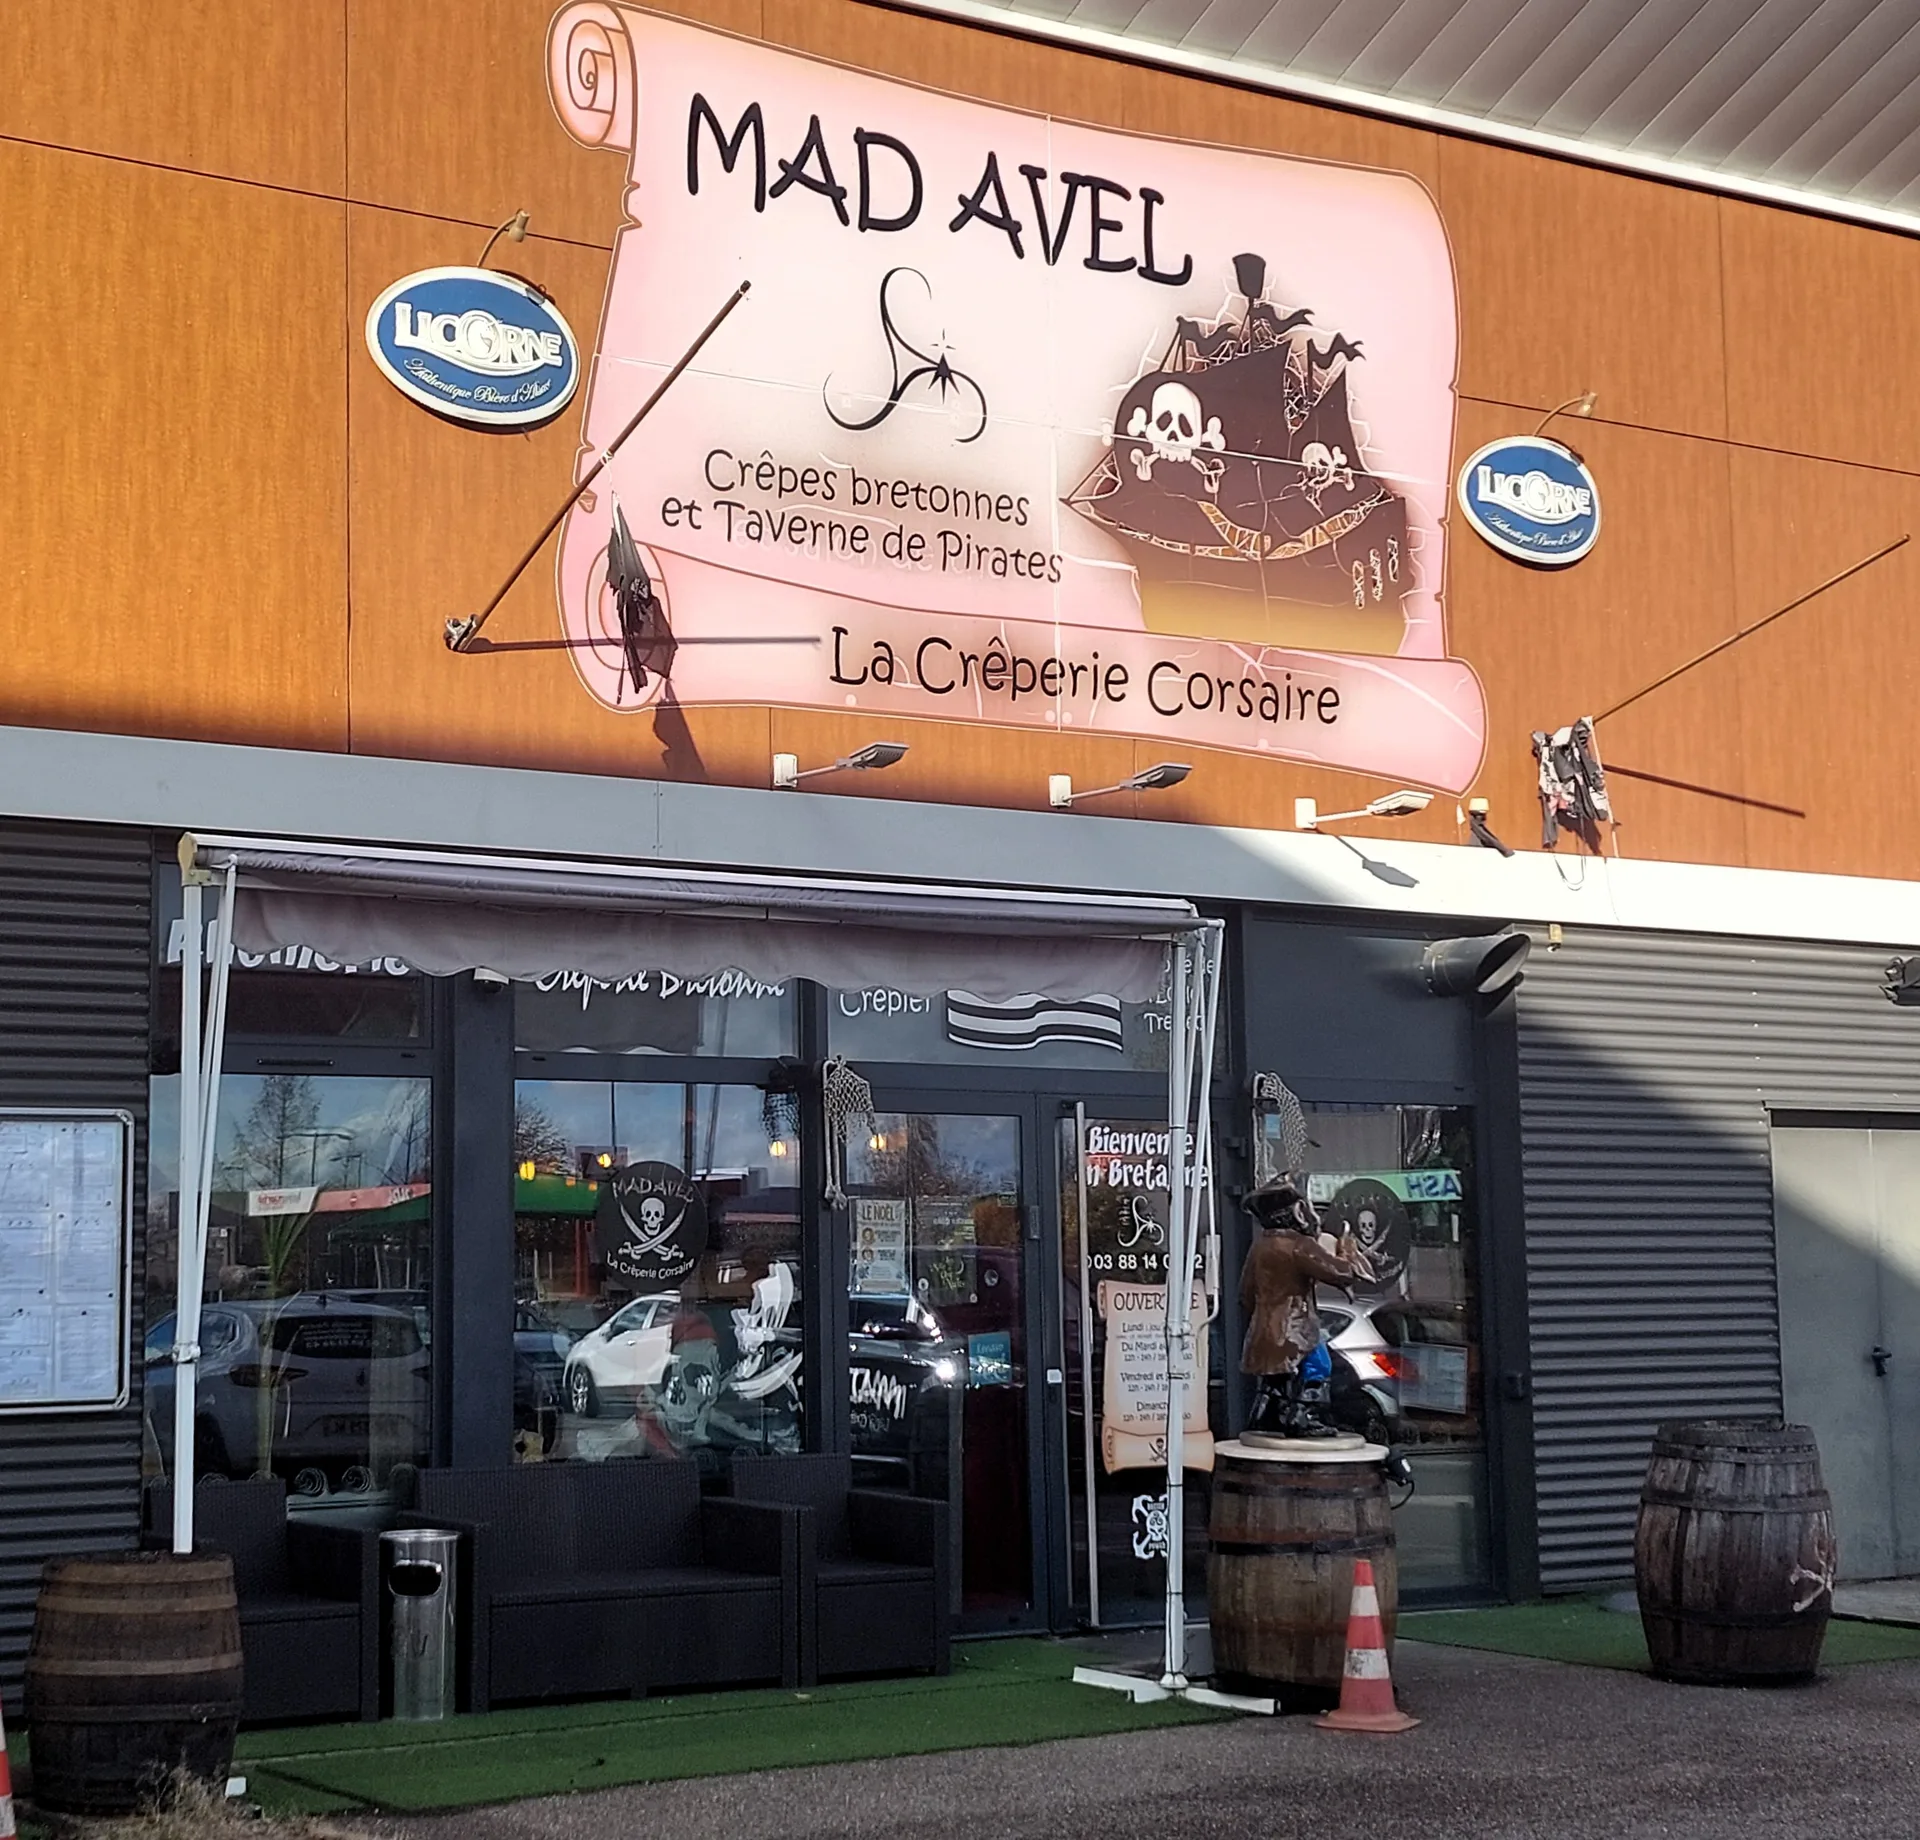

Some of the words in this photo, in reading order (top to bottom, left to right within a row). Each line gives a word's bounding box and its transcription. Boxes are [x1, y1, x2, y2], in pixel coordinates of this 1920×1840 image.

[686, 92, 924, 233] MAD
[948, 150, 1193, 287] AVEL
[393, 301, 563, 376] LICORNE
[704, 448, 838, 501] Crêpes
[850, 466, 1030, 527] bretonnes
[1477, 465, 1592, 525] LICORNE
[661, 496, 703, 530] et
[712, 500, 870, 554] Taverne
[882, 523, 927, 562] de
[936, 529, 1064, 583] Pirates
[829, 625, 896, 687] La
[915, 637, 1130, 704] Crêperie
[1146, 661, 1342, 726] Corsaire
[1089, 1126, 1193, 1156] Bienvene
[1094, 1254, 1113, 1269] 03
[1118, 1255, 1137, 1270] 88
[1142, 1255, 1158, 1270] 14
